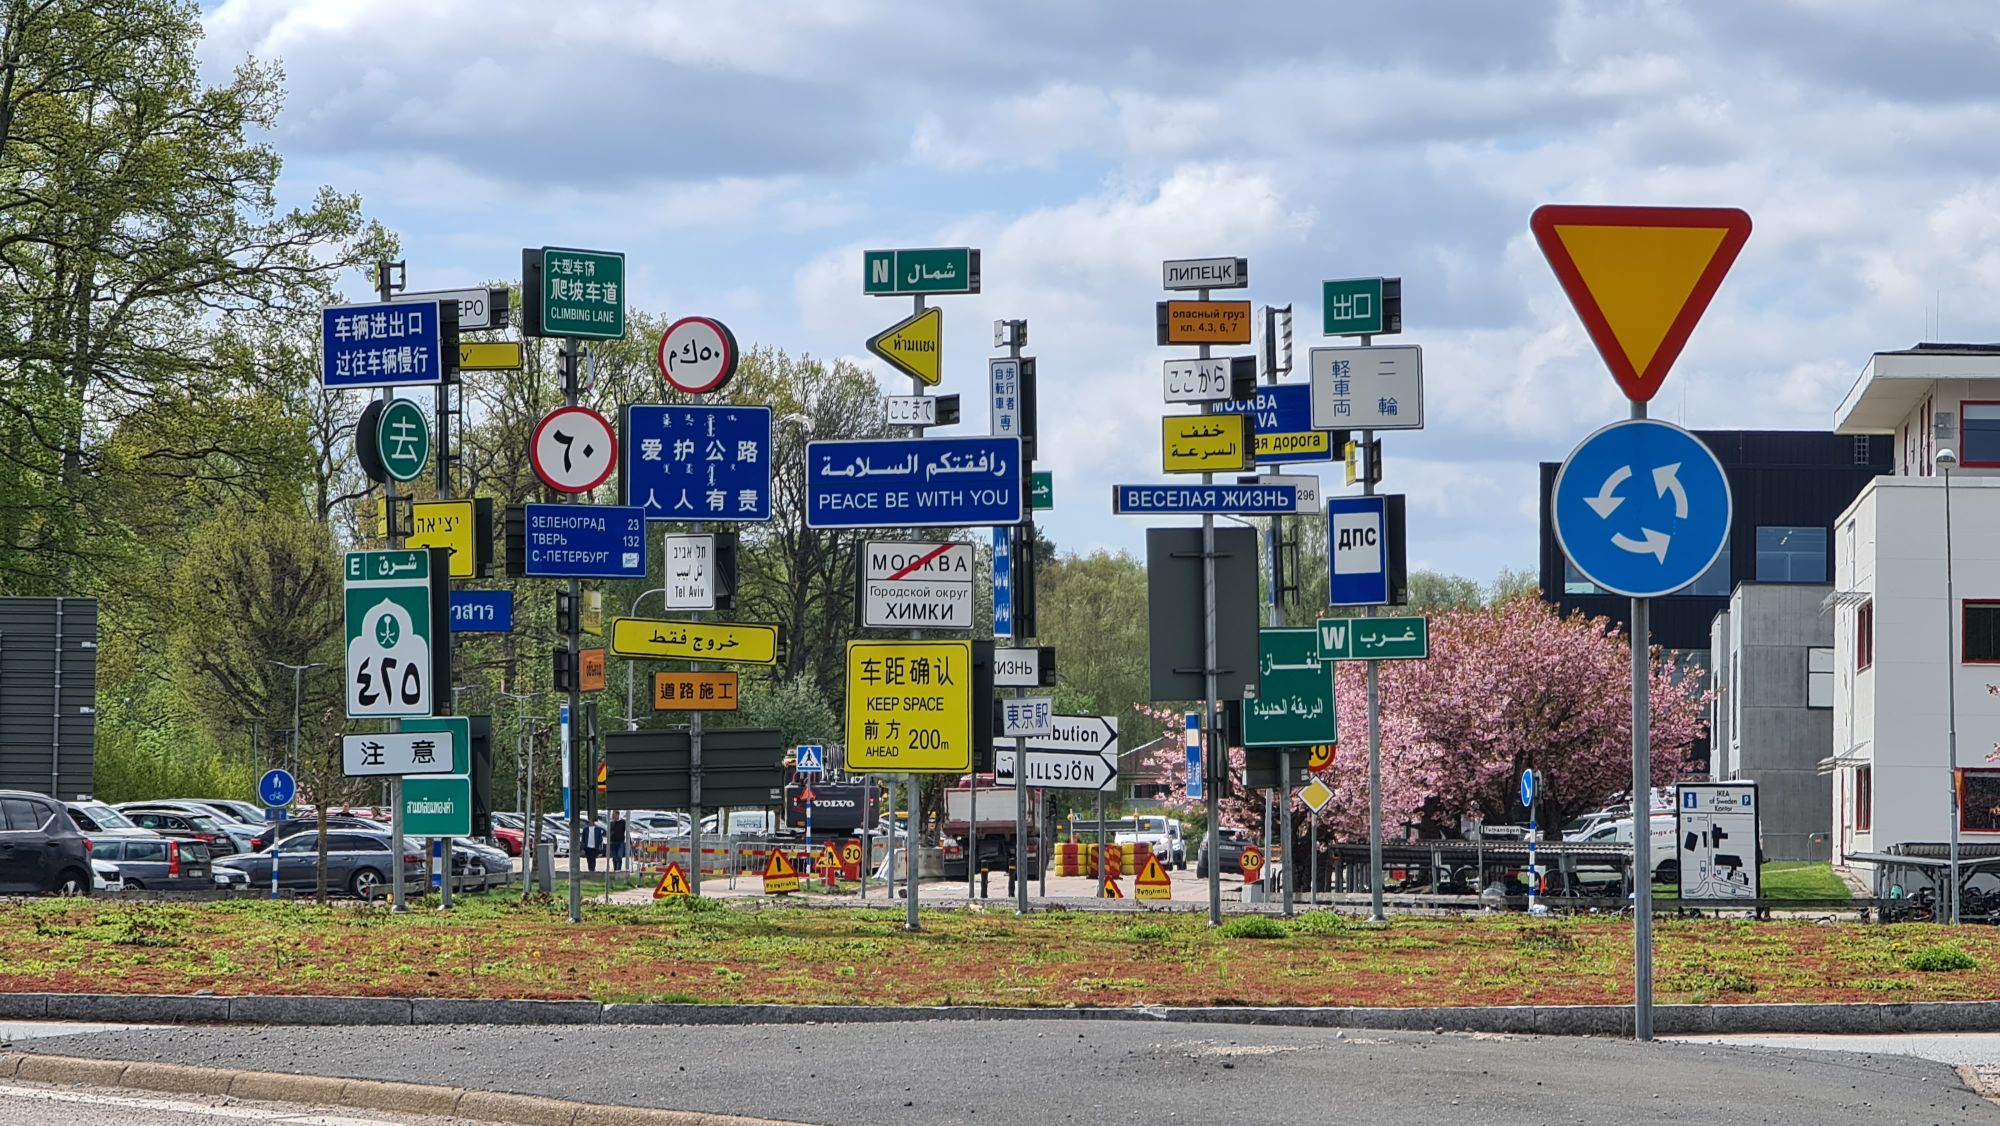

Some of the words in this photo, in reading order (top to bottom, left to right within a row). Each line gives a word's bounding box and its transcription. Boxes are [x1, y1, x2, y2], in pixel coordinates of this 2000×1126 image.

[551, 258, 595, 276] 大型车辆
[872, 259, 889, 284] N
[907, 262, 956, 284] شمال
[1169, 265, 1231, 281] ЛИПЕЦК
[551, 278, 618, 304] 爬坡车道
[551, 307, 590, 321] CLIMBING
[593, 310, 614, 323] LANE
[1172, 309, 1220, 319] опасный
[1223, 311, 1245, 321] груз
[1333, 293, 1371, 320] 出口
[335, 312, 423, 342] 车辆进出口
[1180, 324, 1196, 332] кл.
[1198, 323, 1217, 333] 4.3,
[1219, 323, 1229, 333] 6,
[1231, 323, 1238, 332] 7
[336, 346, 429, 377] 过往车辆慢行
[1006, 367, 1015, 411] 歩行者
[1170, 366, 1226, 394] ここから
[1331, 360, 1351, 417] 軽車両
[1378, 361, 1398, 417] 二輪
[891, 400, 933, 421] ここまで
[390, 416, 418, 463] 去
[1181, 424, 1225, 439] خفف
[641, 438, 759, 463] 爱护公路
[1172, 442, 1236, 460] السرعة
[1273, 435, 1321, 451] дорога
[821, 453, 919, 478] السلامة
[926, 449, 1007, 483] رافقتكم
[643, 488, 759, 511] 人人有责
[819, 493, 878, 510] PEACE
[886, 492, 909, 508] BE
[916, 490, 963, 508] WITH
[970, 489, 1009, 506] YOU
[1128, 491, 1216, 508] ВЕСЕЛАЯ
[1222, 490, 1289, 507] ЖИЗНЬ
[1297, 489, 1315, 501] 296
[417, 516, 460, 533] יציאה
[532, 516, 606, 532] ЗЕЛЕНОГРАД
[627, 519, 640, 531] 23
[532, 533, 567, 546] ТВЕРЬ
[622, 535, 640, 547] 132
[1338, 527, 1377, 550] ДПС
[532, 550, 610, 563] С.-ПЕТЕРБУРГ
[674, 546, 692, 559] אביב
[696, 544, 706, 559] תל
[351, 560, 360, 575] E
[378, 553, 418, 576] شرق
[872, 554, 968, 572] МОСКВА
[675, 585, 686, 598] Tel
[689, 585, 705, 598] Aviv
[870, 585, 930, 599] Городской
[935, 588, 969, 601] округ
[451, 603, 495, 620] วสาร
[885, 602, 953, 620] ХИМКИ
[648, 629, 687, 645] فقط
[692, 633, 740, 651] خروج
[1322, 627, 1346, 650] W
[1359, 627, 1417, 648] غرب
[861, 656, 954, 686] 车距确认
[356, 656, 421, 706] ٤٢٥
[660, 682, 733, 700] 道路施工
[867, 697, 900, 711] KEEP
[903, 697, 944, 711] SPACE
[1007, 703, 1049, 731] 東京駅
[864, 718, 901, 741] 前方
[360, 739, 436, 766] 注意
[865, 746, 899, 757] AHEAD
[1026, 760, 1094, 782] ILLSJÖN
[813, 800, 855, 808] VOLVO
[1716, 797, 1738, 805] Sweden
[845, 847, 861, 860] 30
[1243, 854, 1259, 866] 30
